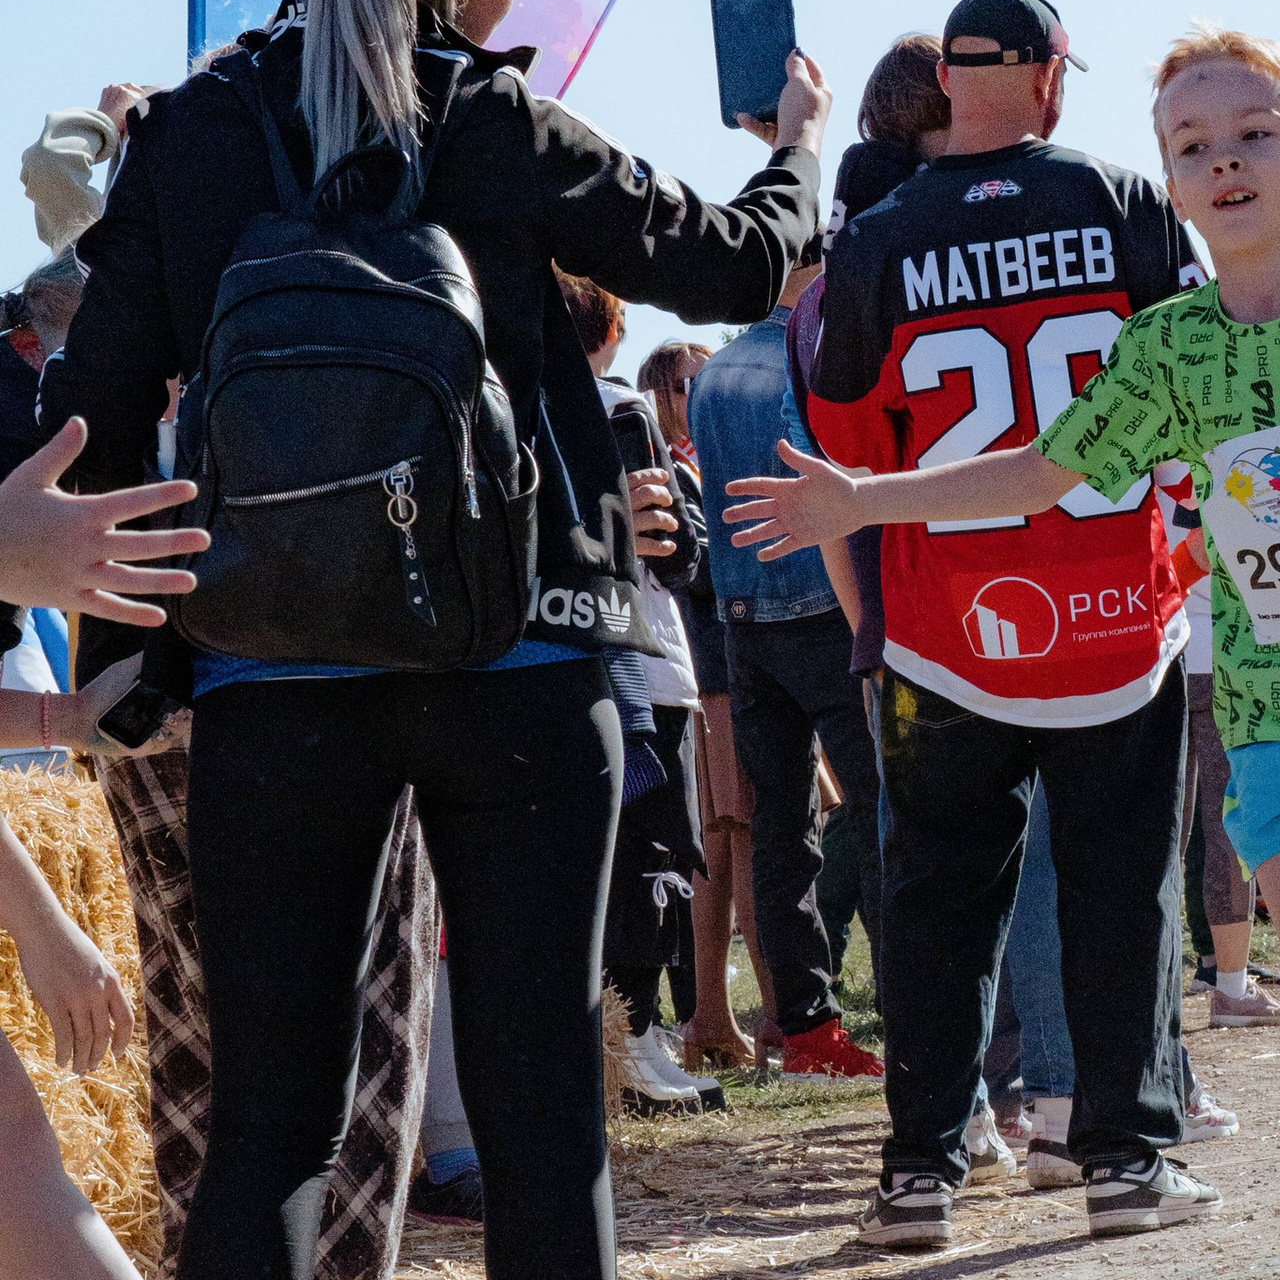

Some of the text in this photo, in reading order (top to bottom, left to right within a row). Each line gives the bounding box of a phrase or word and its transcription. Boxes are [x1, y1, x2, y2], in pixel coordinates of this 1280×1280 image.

[902, 227, 1116, 312] МАТВЕЕВ
[1161, 313, 1173, 350] FILA
[1177, 352, 1206, 366] FILA
[1114, 377, 1150, 400] FILA
[1213, 412, 1243, 429] FILA
[1075, 414, 1109, 460] FILA
[1072, 621, 1151, 643] Группа компаний
[1221, 624, 1240, 656] FILA
